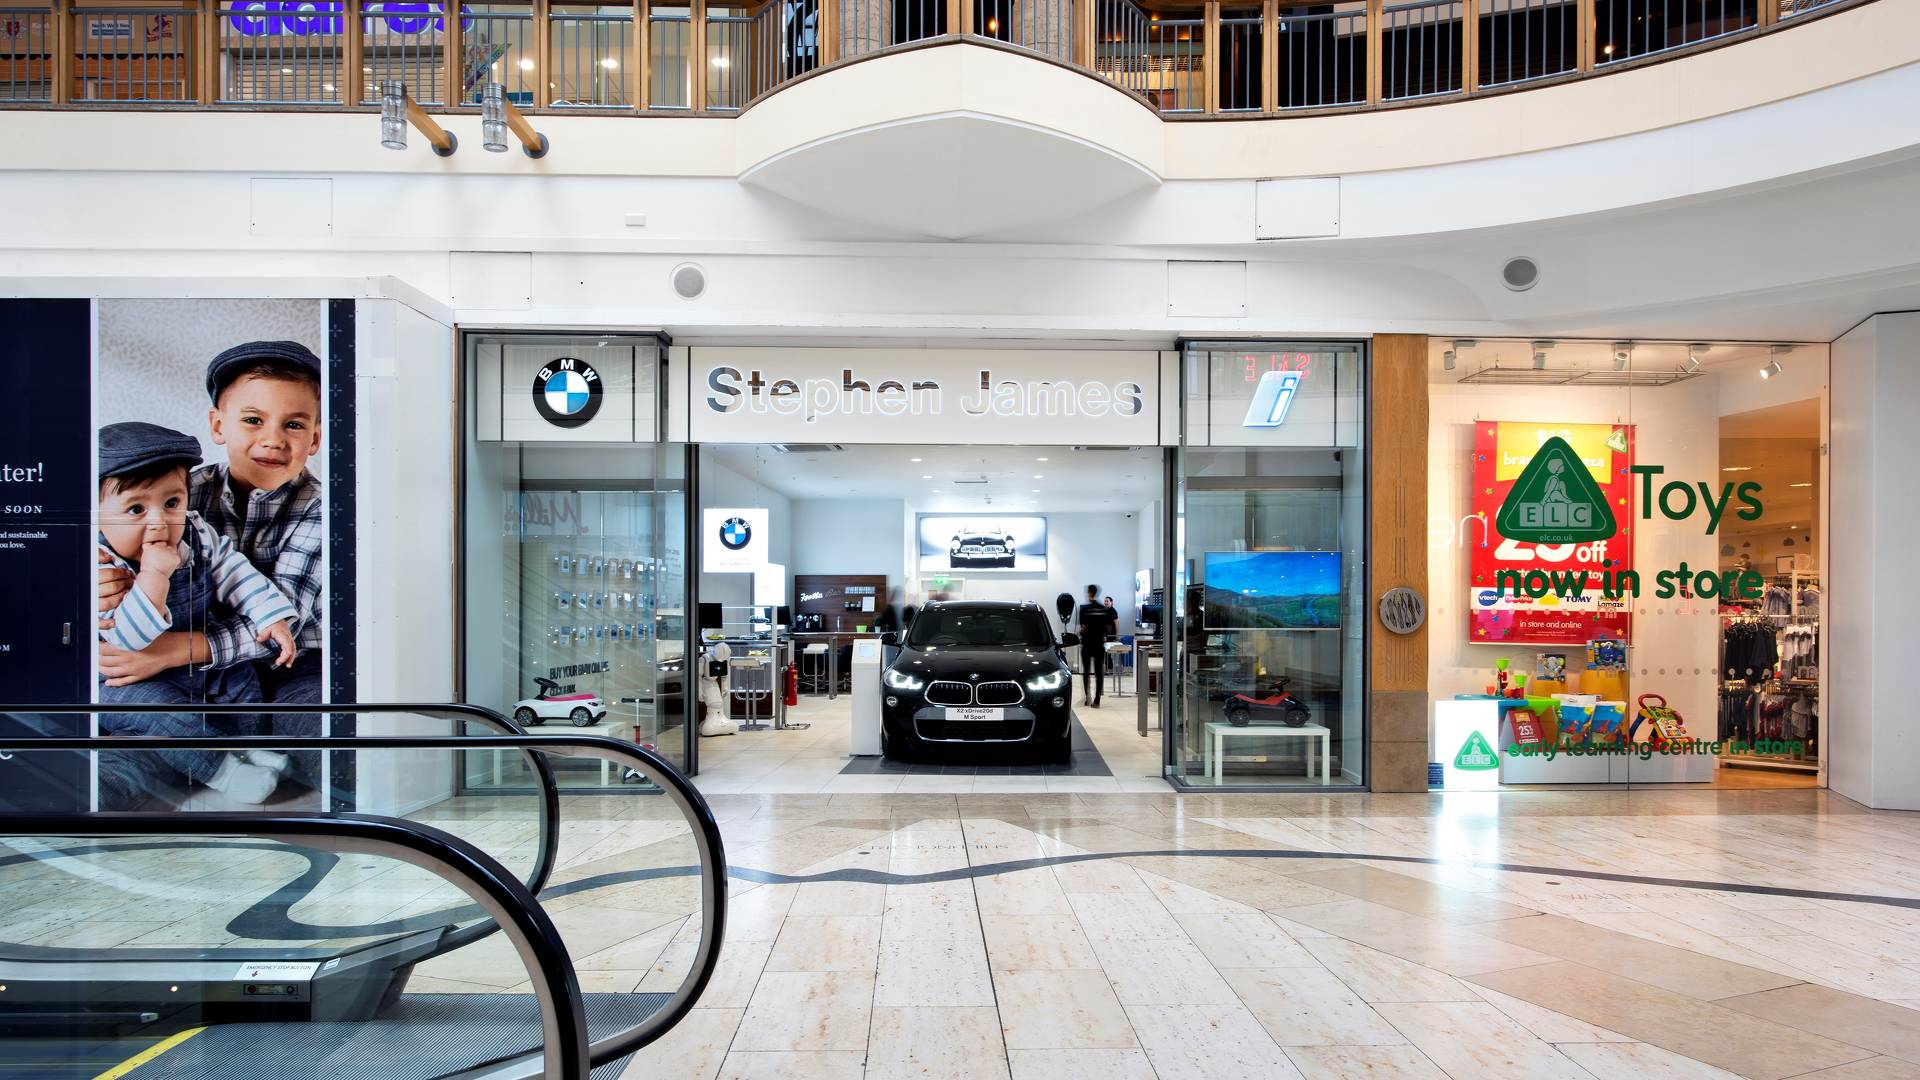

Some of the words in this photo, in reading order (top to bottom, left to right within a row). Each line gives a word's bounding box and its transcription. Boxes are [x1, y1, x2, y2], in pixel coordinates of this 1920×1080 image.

[538, 358, 598, 383] BMW
[707, 366, 941, 422] Stephen
[960, 370, 1143, 417] James
[0, 462, 43, 482] ter!
[1630, 465, 1763, 535] Toys
[5, 505, 42, 514] SOON
[1526, 506, 1587, 523] ELC
[721, 518, 750, 530] BMW
[8, 531, 48, 539] sustainable
[1539, 534, 1573, 542] elc.co.uk
[9, 541, 26, 549] love.
[1576, 540, 1607, 563] off
[1496, 569, 1588, 598] now
[1602, 559, 1640, 598] in
[1655, 562, 1764, 599] store
[1565, 595, 1592, 603] TOMY
[0, 644, 10, 652] M
[550, 667, 562, 680] BUY
[562, 664, 578, 678] YOUR
[1507, 737, 1558, 761] early
[1566, 737, 1653, 761] learning
[1659, 738, 1724, 756] centre
[1730, 737, 1748, 755] in
[1753, 737, 1805, 755] store
